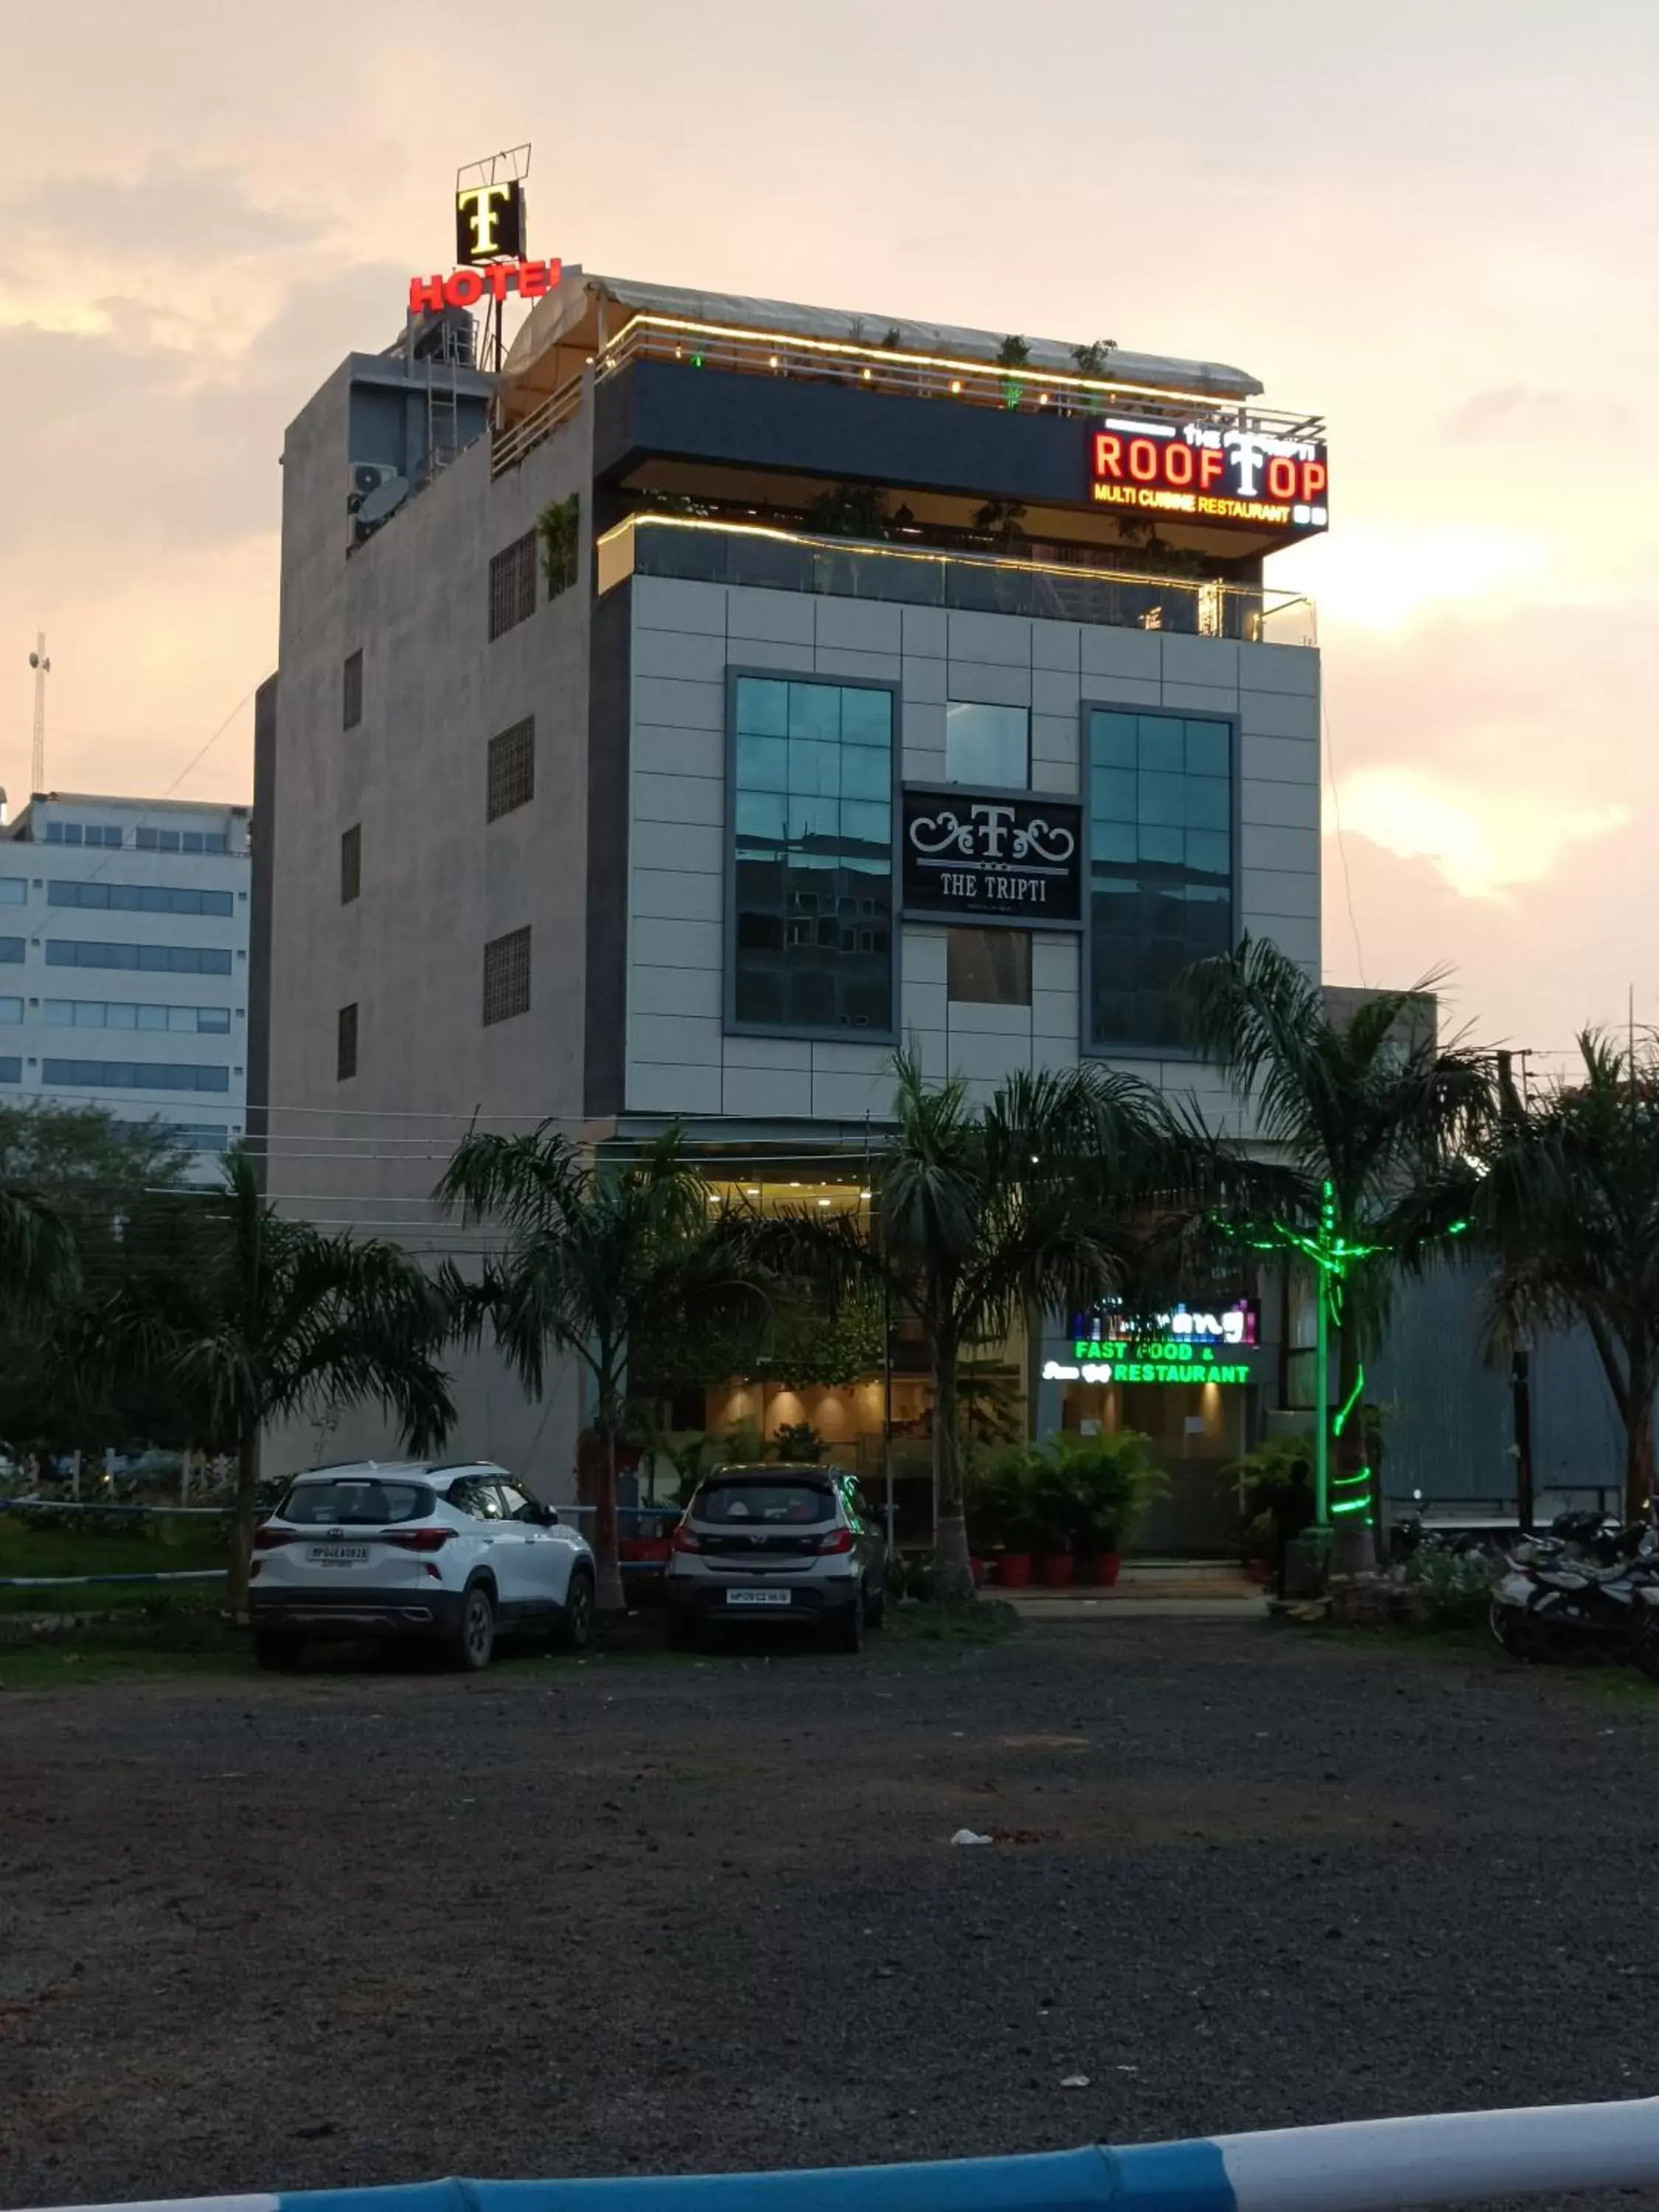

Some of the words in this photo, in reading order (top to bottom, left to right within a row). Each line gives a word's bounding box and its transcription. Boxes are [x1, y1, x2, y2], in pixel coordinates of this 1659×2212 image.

[1095, 484, 1136, 504] MULTI
[1198, 497, 1290, 524] RESTAURANT
[940, 872, 977, 897] THE
[985, 876, 1046, 902] TRIPTI
[1075, 1341, 1127, 1360] FAST
[1203, 1347, 1214, 1360] &
[1114, 1364, 1250, 1383] RESTAURANT
